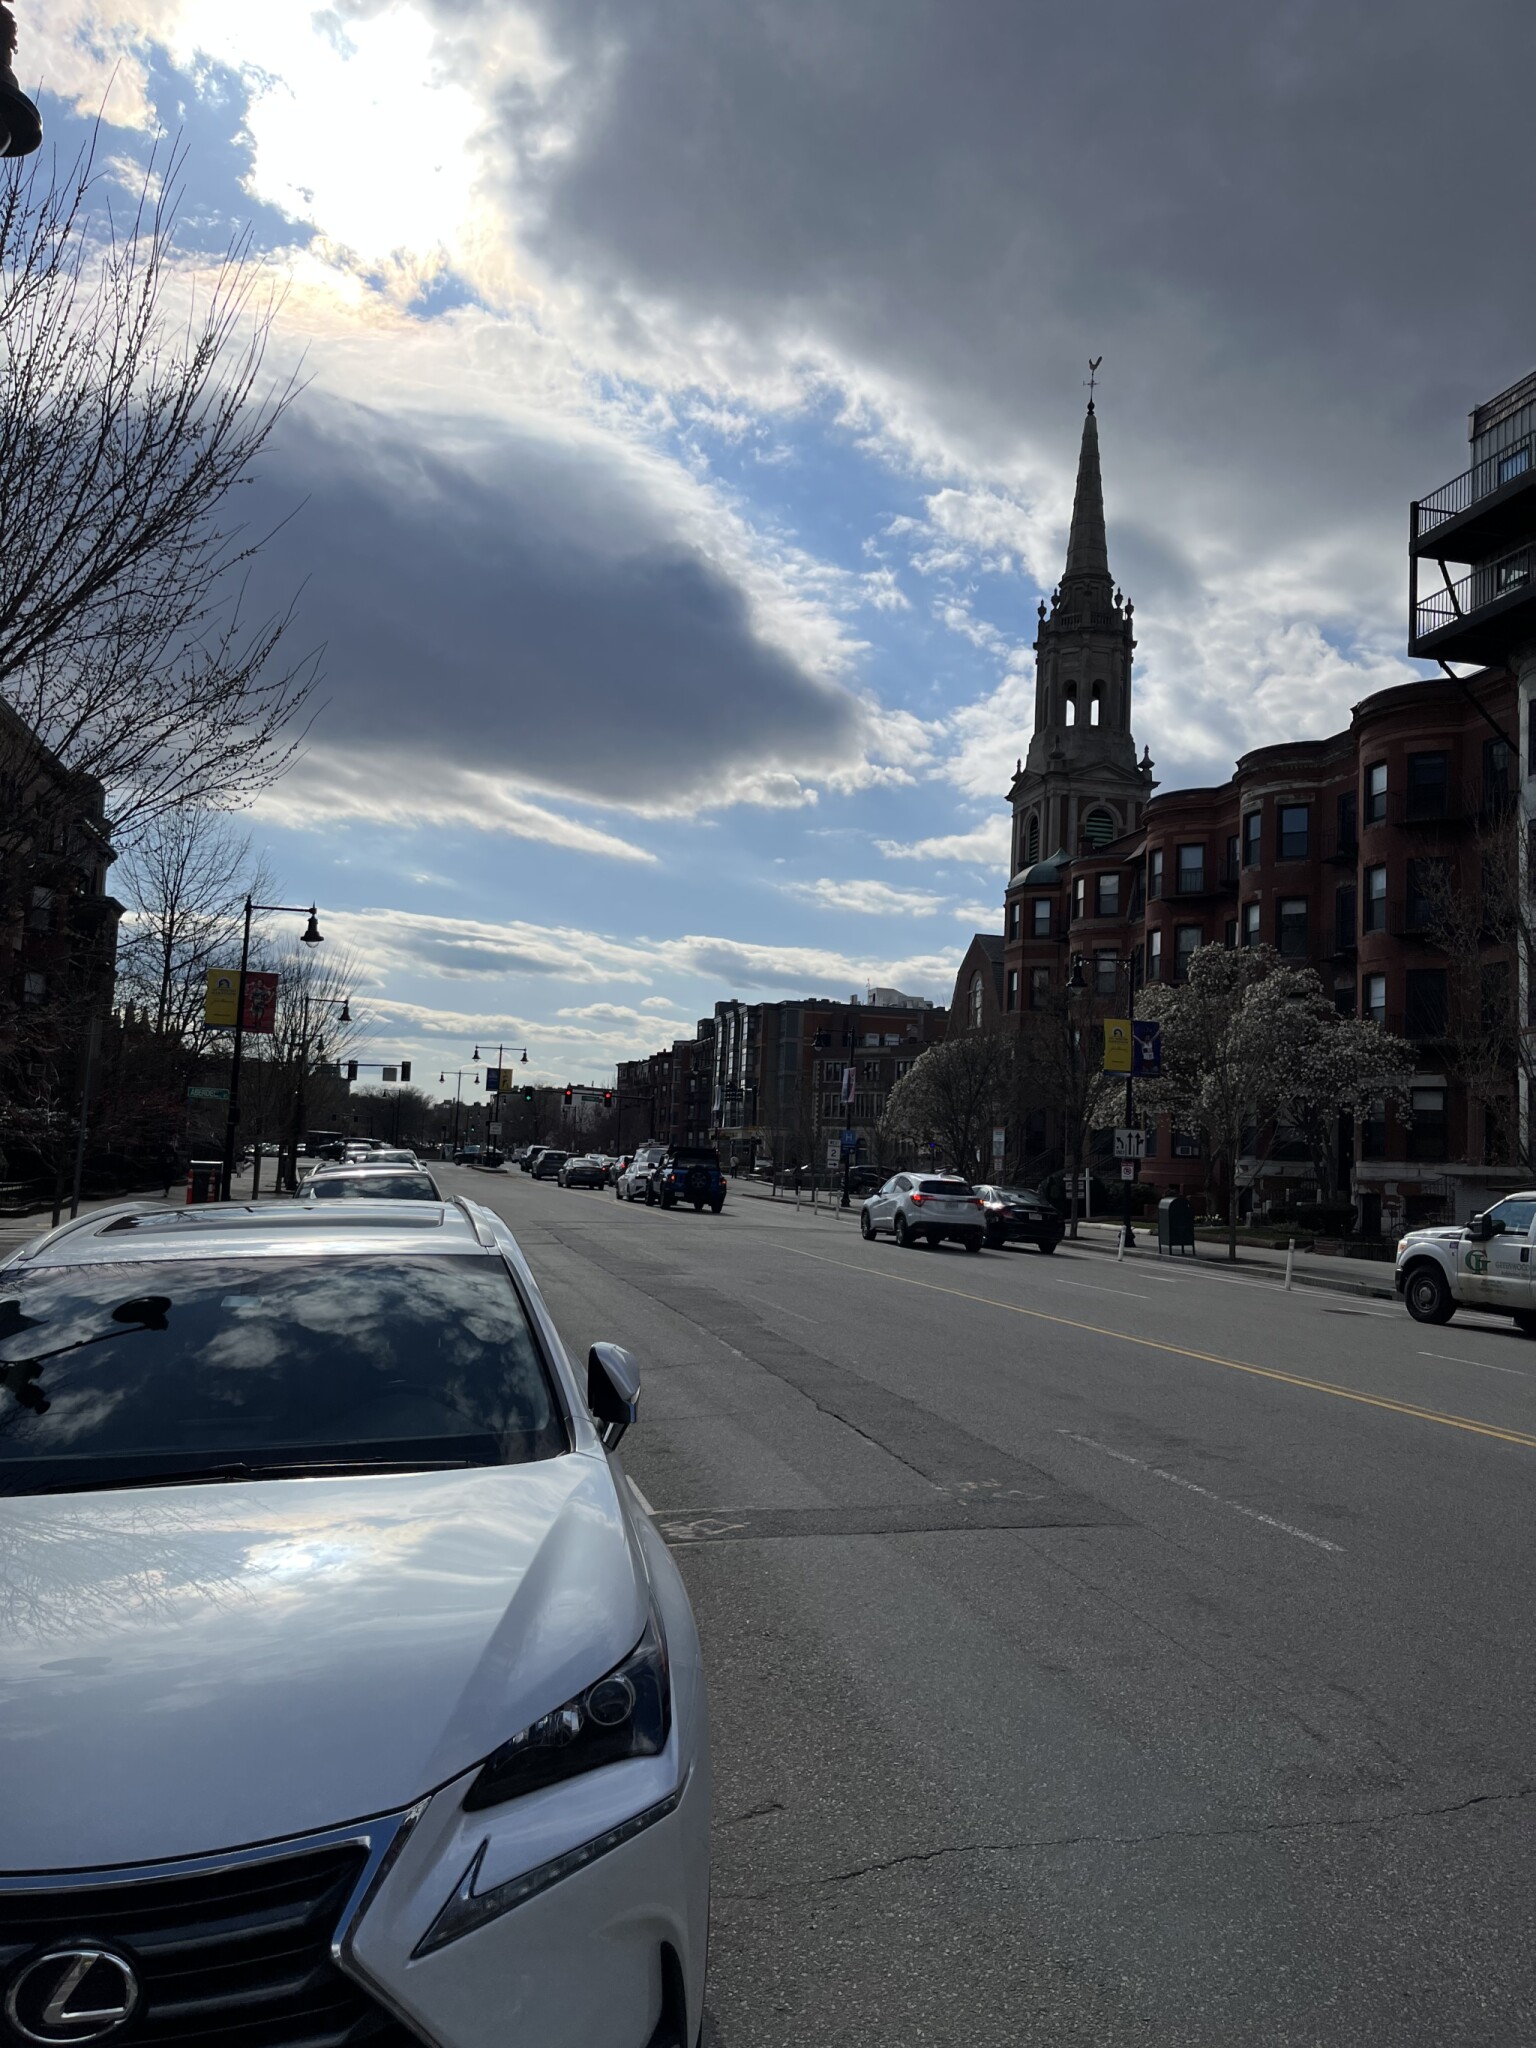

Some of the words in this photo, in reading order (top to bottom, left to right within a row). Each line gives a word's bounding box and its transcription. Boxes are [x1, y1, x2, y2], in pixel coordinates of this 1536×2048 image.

[190, 1088, 222, 1098] ABERDE
[845, 1133, 853, 1141] H
[831, 1149, 837, 1157] 2
